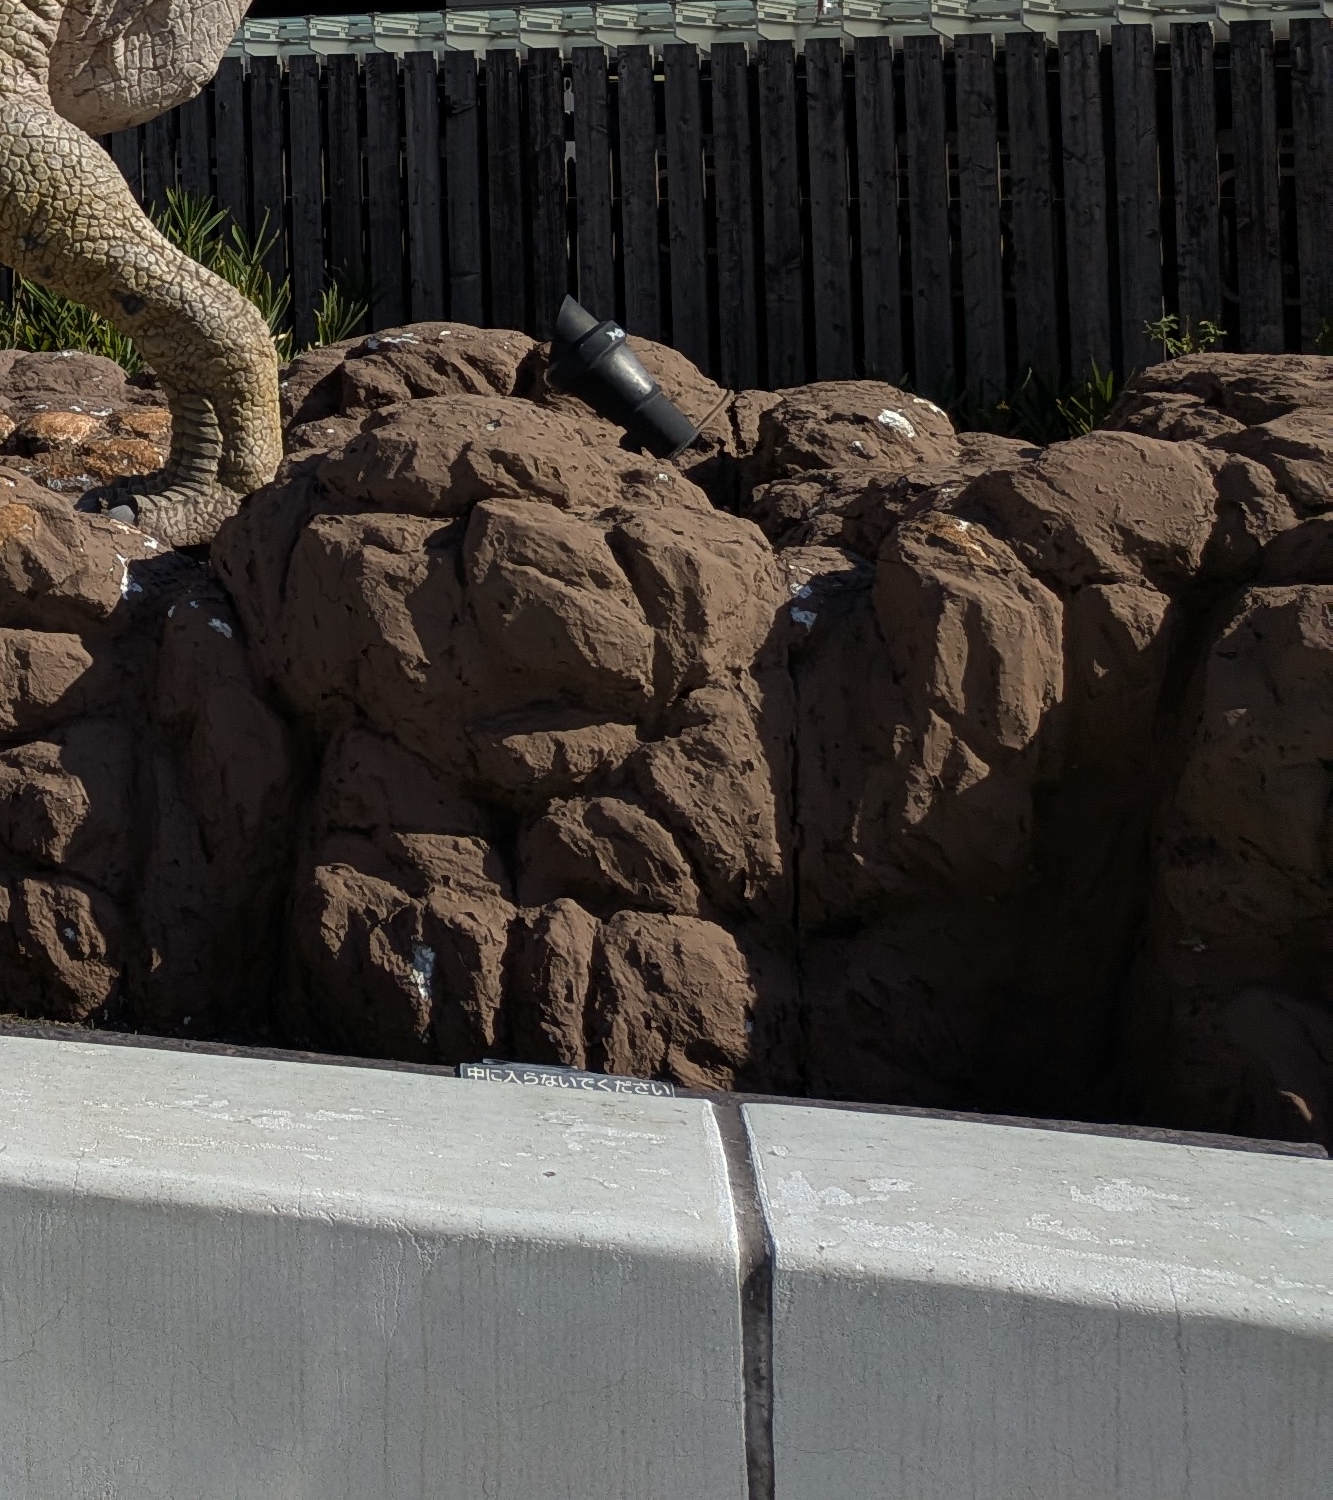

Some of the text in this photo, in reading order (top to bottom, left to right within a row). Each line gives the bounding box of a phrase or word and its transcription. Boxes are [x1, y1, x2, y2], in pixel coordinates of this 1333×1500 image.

[467, 1066, 671, 1097] 中に入らないでください
